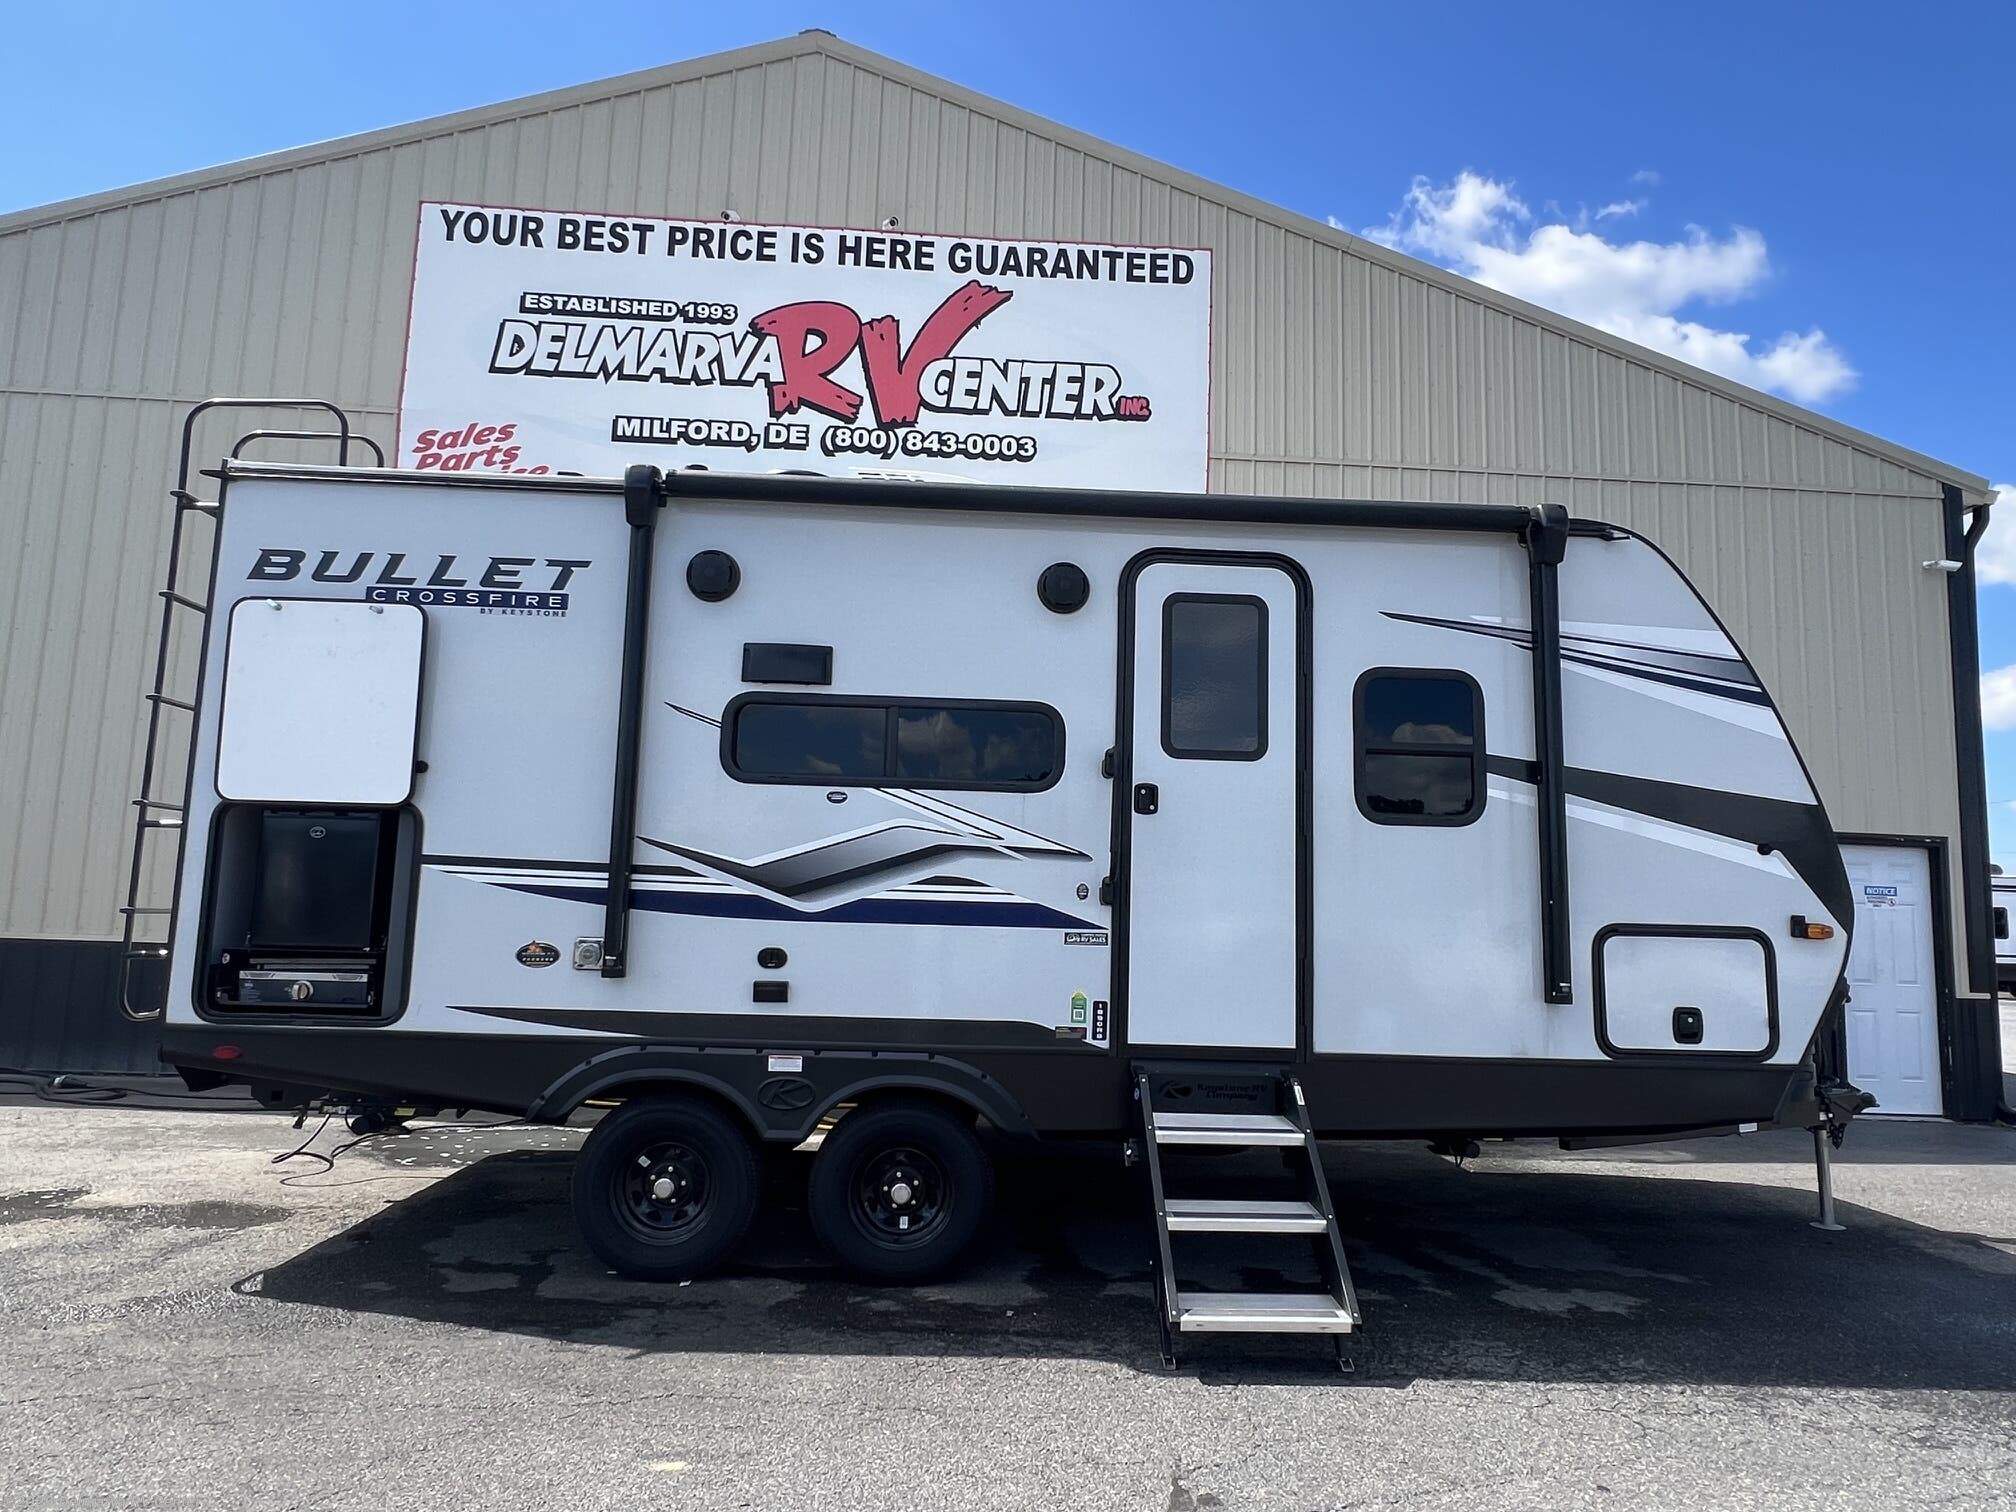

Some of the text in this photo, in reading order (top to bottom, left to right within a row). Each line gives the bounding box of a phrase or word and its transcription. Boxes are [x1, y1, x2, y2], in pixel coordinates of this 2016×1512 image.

[440, 209, 1195, 285] YOUR BEST PRICE IS HERE GUARANTEED
[520, 292, 739, 324] ESTABLISHED 1993
[489, 318, 787, 388] DELMARVA
[748, 279, 1014, 428] RV
[917, 356, 1122, 421] CENTER
[412, 422, 518, 454] Sales
[611, 415, 1038, 463] MILFORD, DE (800) 843-0003
[415, 445, 522, 472] Parts
[246, 548, 593, 591] BULLET
[371, 588, 564, 608] CROSSFIRE
[480, 607, 567, 618] BY KEYSTONE
[1866, 887, 1896, 895] NOTICE
